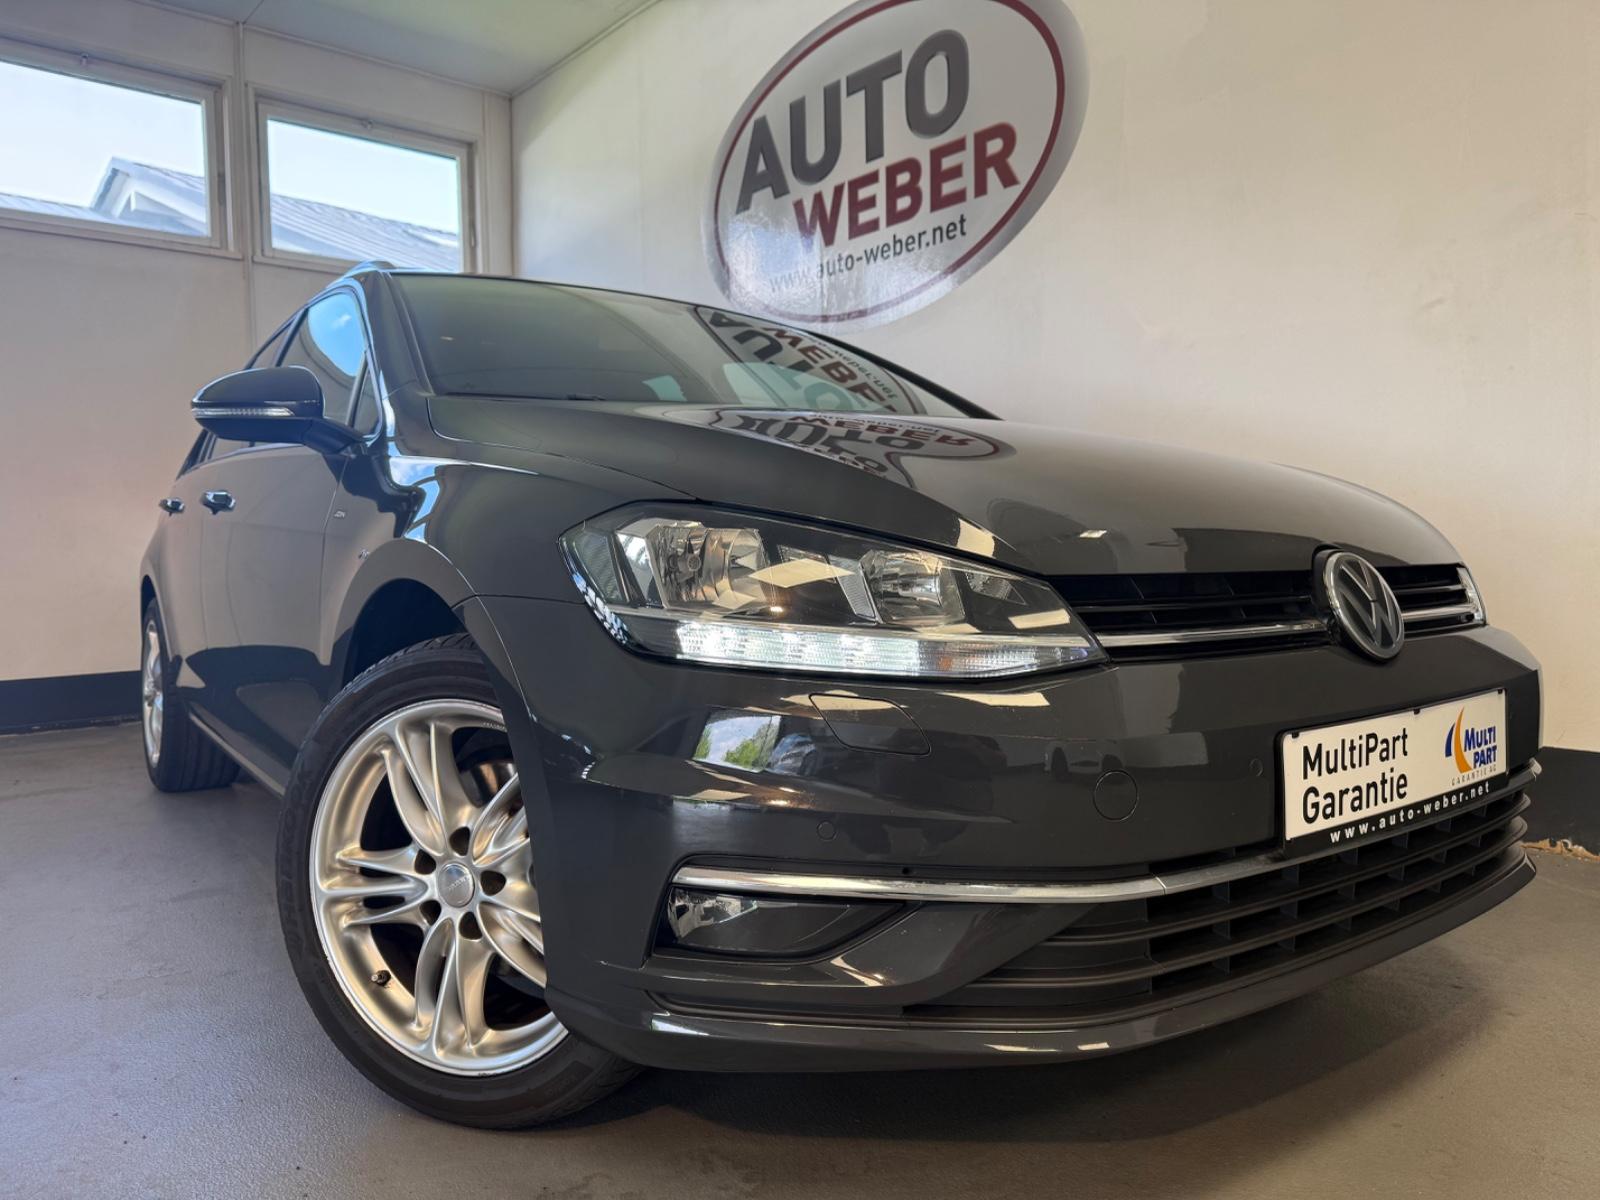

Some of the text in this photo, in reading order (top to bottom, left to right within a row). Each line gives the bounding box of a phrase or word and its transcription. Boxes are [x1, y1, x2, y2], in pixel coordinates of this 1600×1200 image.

[736, 29, 970, 214] AUTO
[793, 122, 1020, 253] WEBER
[769, 214, 967, 293] wwwauto-weber.net
[1303, 728, 1408, 780] MultiPart
[1464, 726, 1496, 752] MULTI
[1473, 745, 1498, 769] PART
[1303, 768, 1408, 824] Garantie
[1330, 782, 1490, 843] www.auto-weber.net
